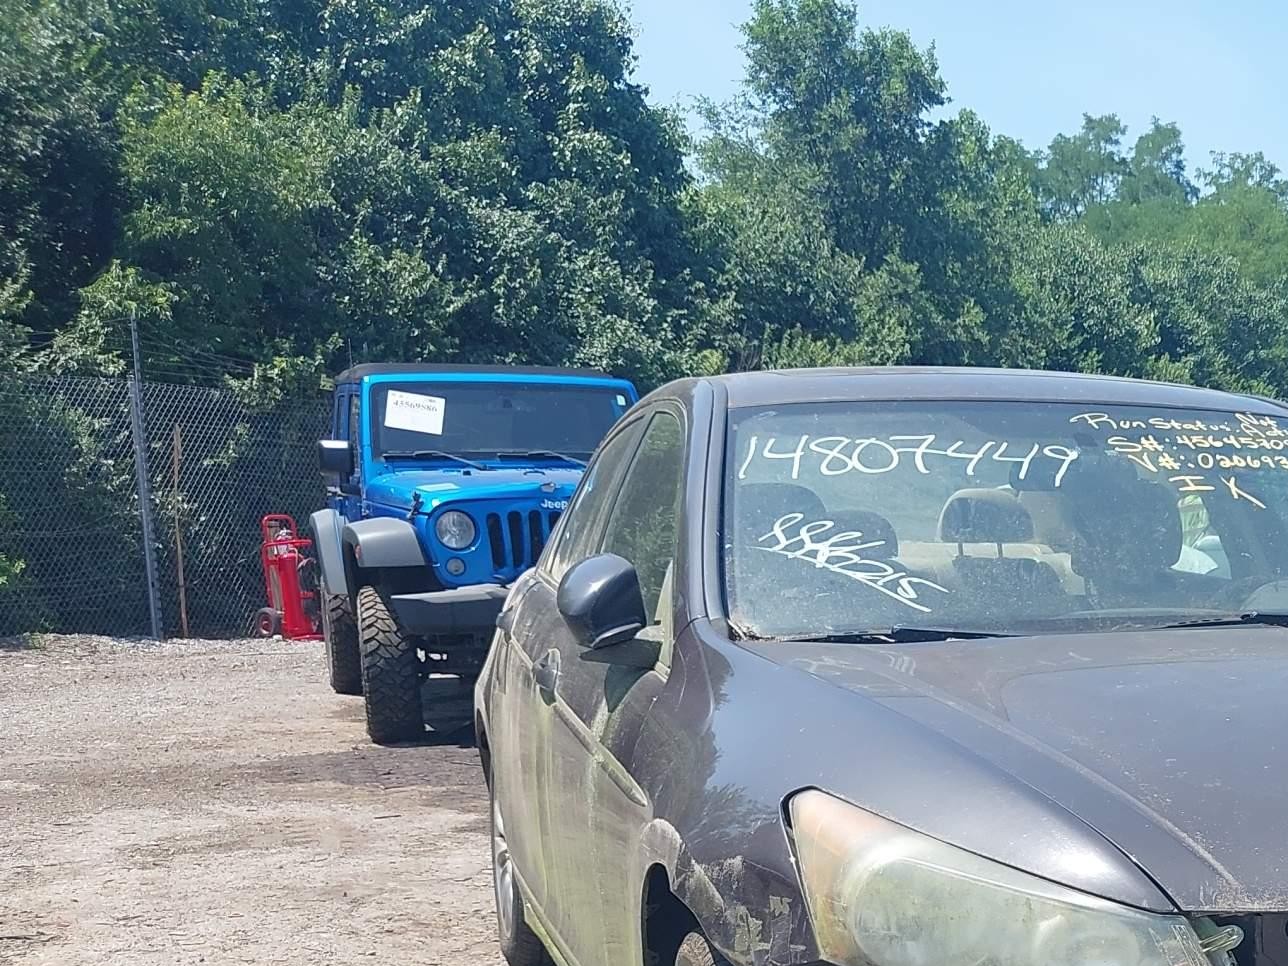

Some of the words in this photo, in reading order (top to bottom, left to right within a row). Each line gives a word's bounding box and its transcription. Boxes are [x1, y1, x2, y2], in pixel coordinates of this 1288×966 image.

[1070, 413, 1147, 431] Run
[1235, 411, 1278, 427] Not
[738, 434, 1079, 487] 14807449
[540, 498, 569, 510] Jeep
